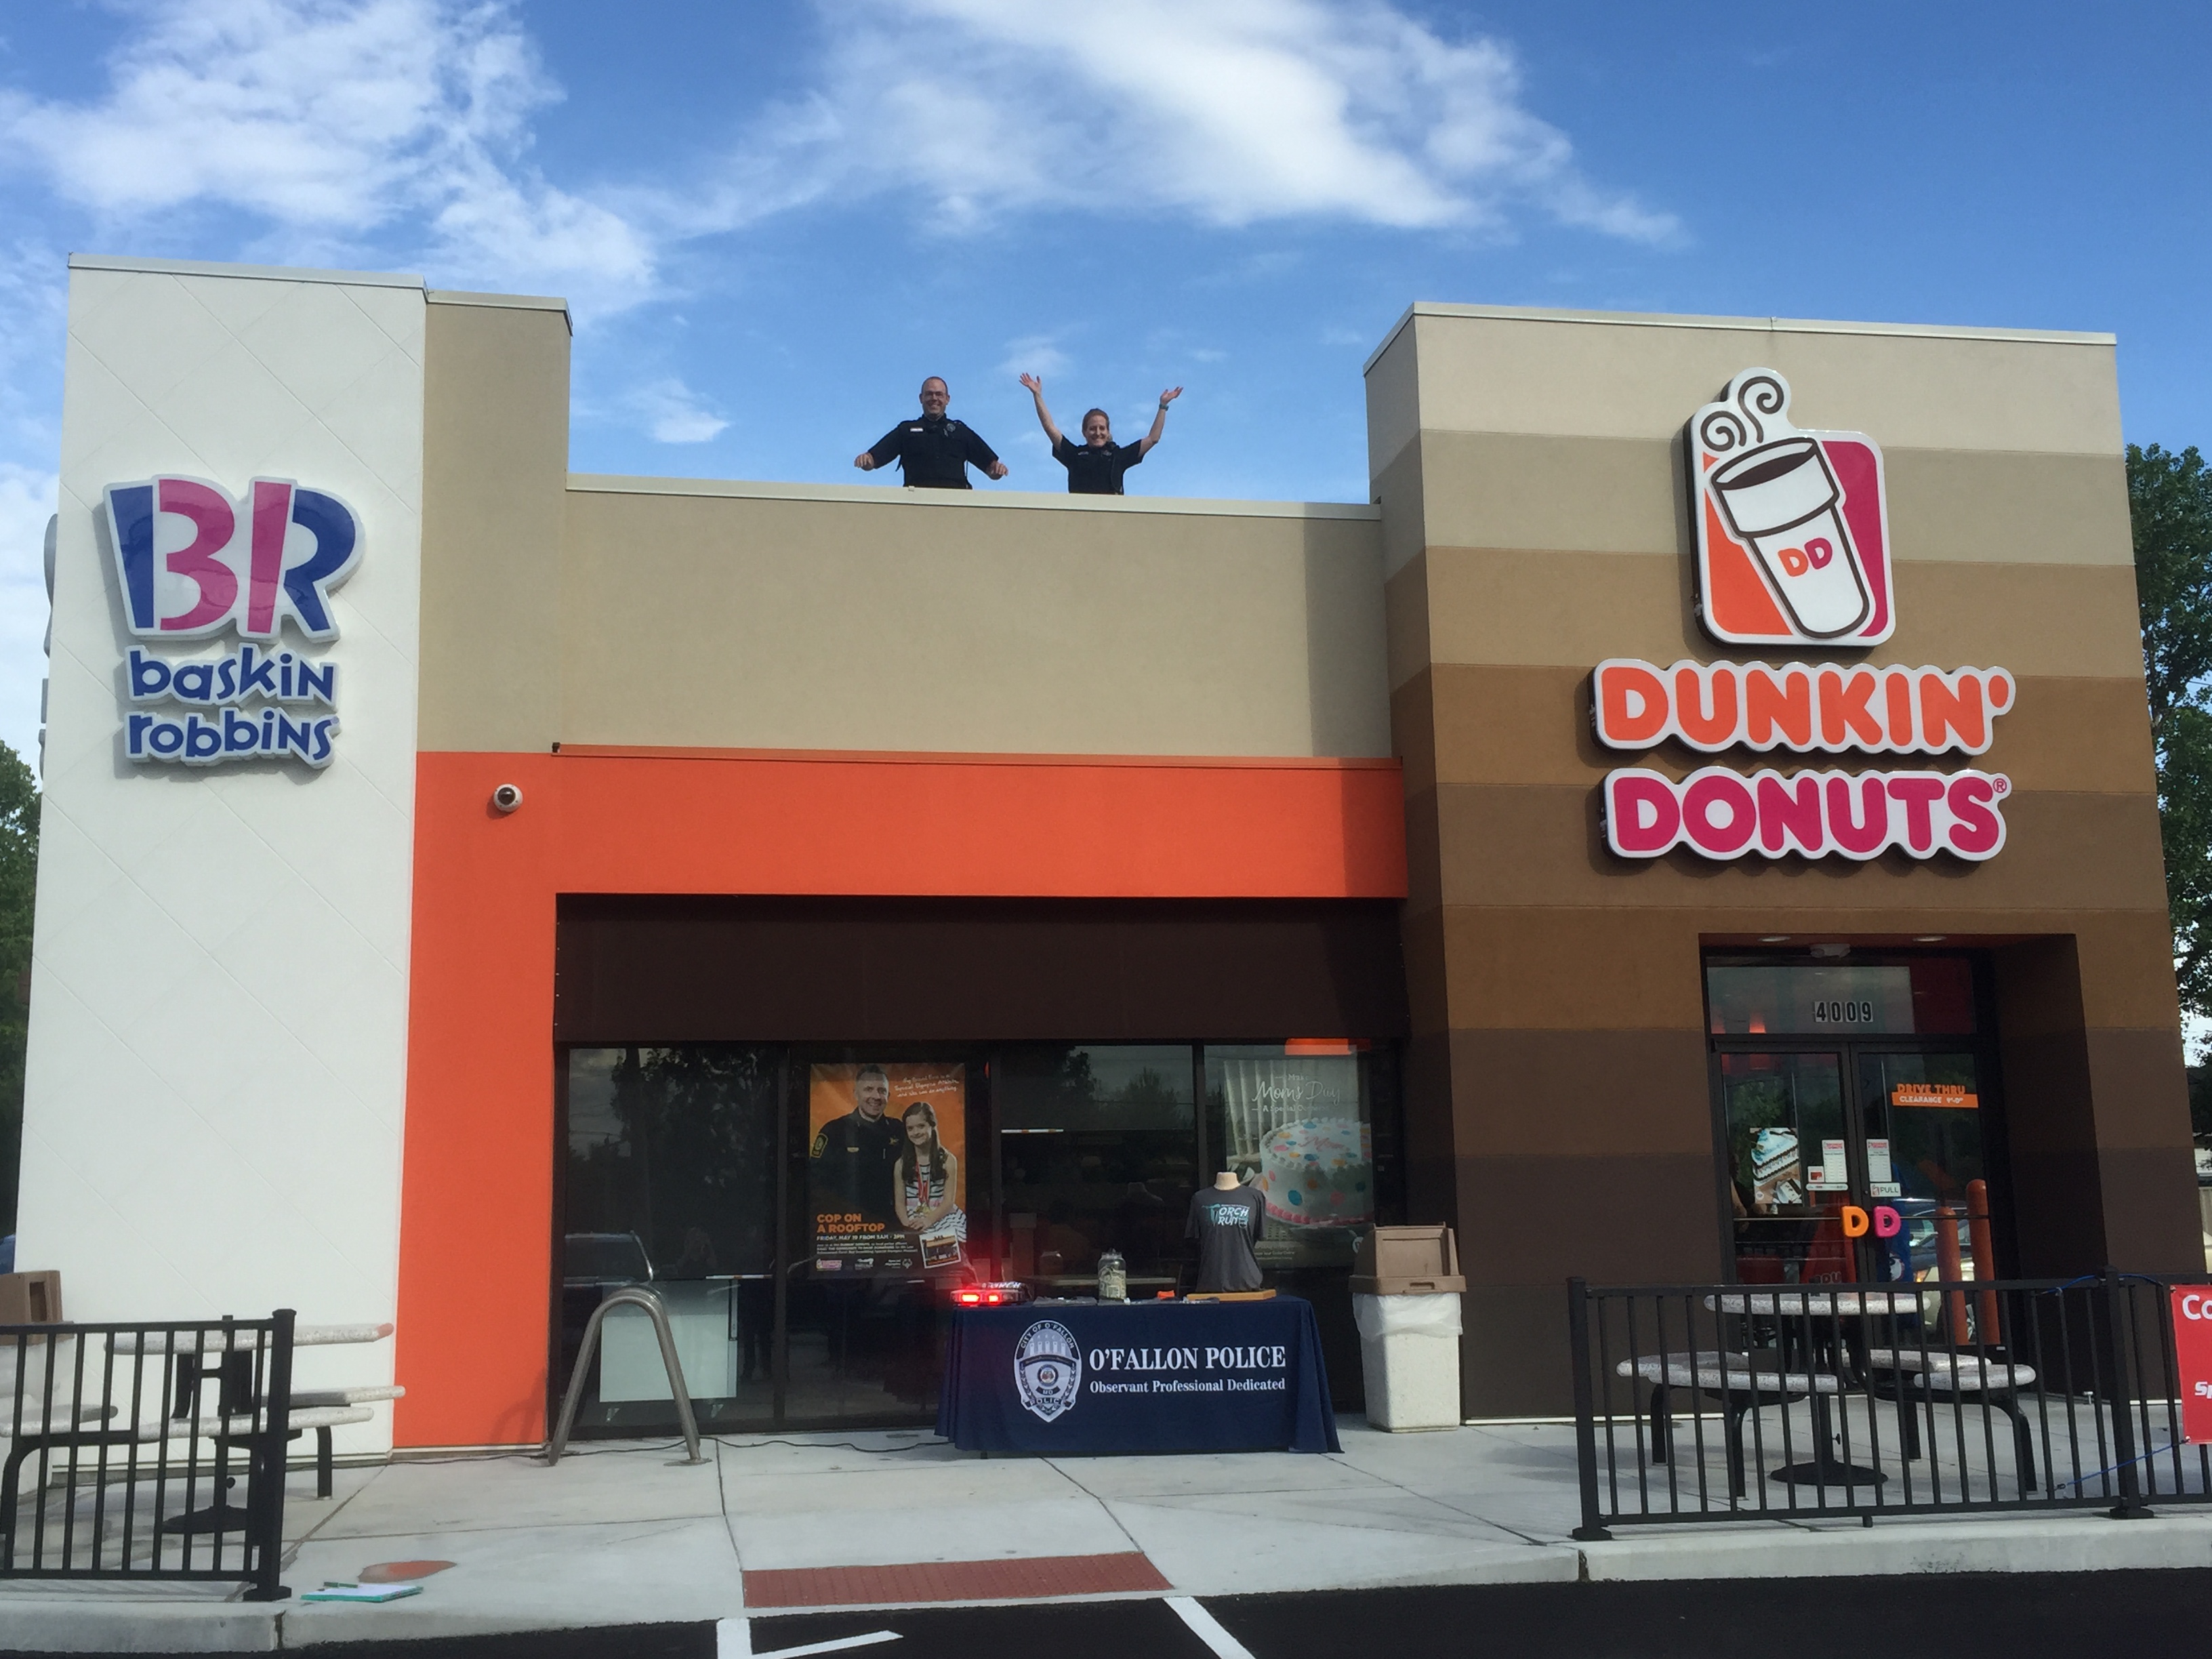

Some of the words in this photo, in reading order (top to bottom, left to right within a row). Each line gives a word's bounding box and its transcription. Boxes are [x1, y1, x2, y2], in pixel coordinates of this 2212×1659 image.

[110, 478, 356, 634] BR
[1777, 537, 1833, 577] DD
[1601, 666, 2009, 749] DUNKIN'
[1816, 1001, 1872, 1022] 4009
[1305, 1080, 1340, 1105] Day
[1897, 1083, 1931, 1094] DRIVE
[1933, 1084, 1966, 1095] THRU
[1899, 1095, 1942, 1104] CLEARANCE
[1262, 1105, 1269, 1113] A
[1879, 1186, 1899, 1194] PULL
[817, 1214, 842, 1223] COP
[844, 1213, 862, 1223] ON
[1217, 1216, 1239, 1226] RUN
[817, 1224, 825, 1233] A
[827, 1223, 885, 1233] ROOFTOP
[1021, 1332, 1033, 1349] CITY
[1032, 1323, 1042, 1334] OF
[1044, 1322, 1075, 1349] O'FALLON
[1089, 1347, 1198, 1372] O'FALLON
[1205, 1345, 1286, 1369] POLICE
[1089, 1380, 1149, 1393] Observant
[1152, 1379, 1224, 1393] Professional
[1227, 1377, 1286, 1391] Dedicated
